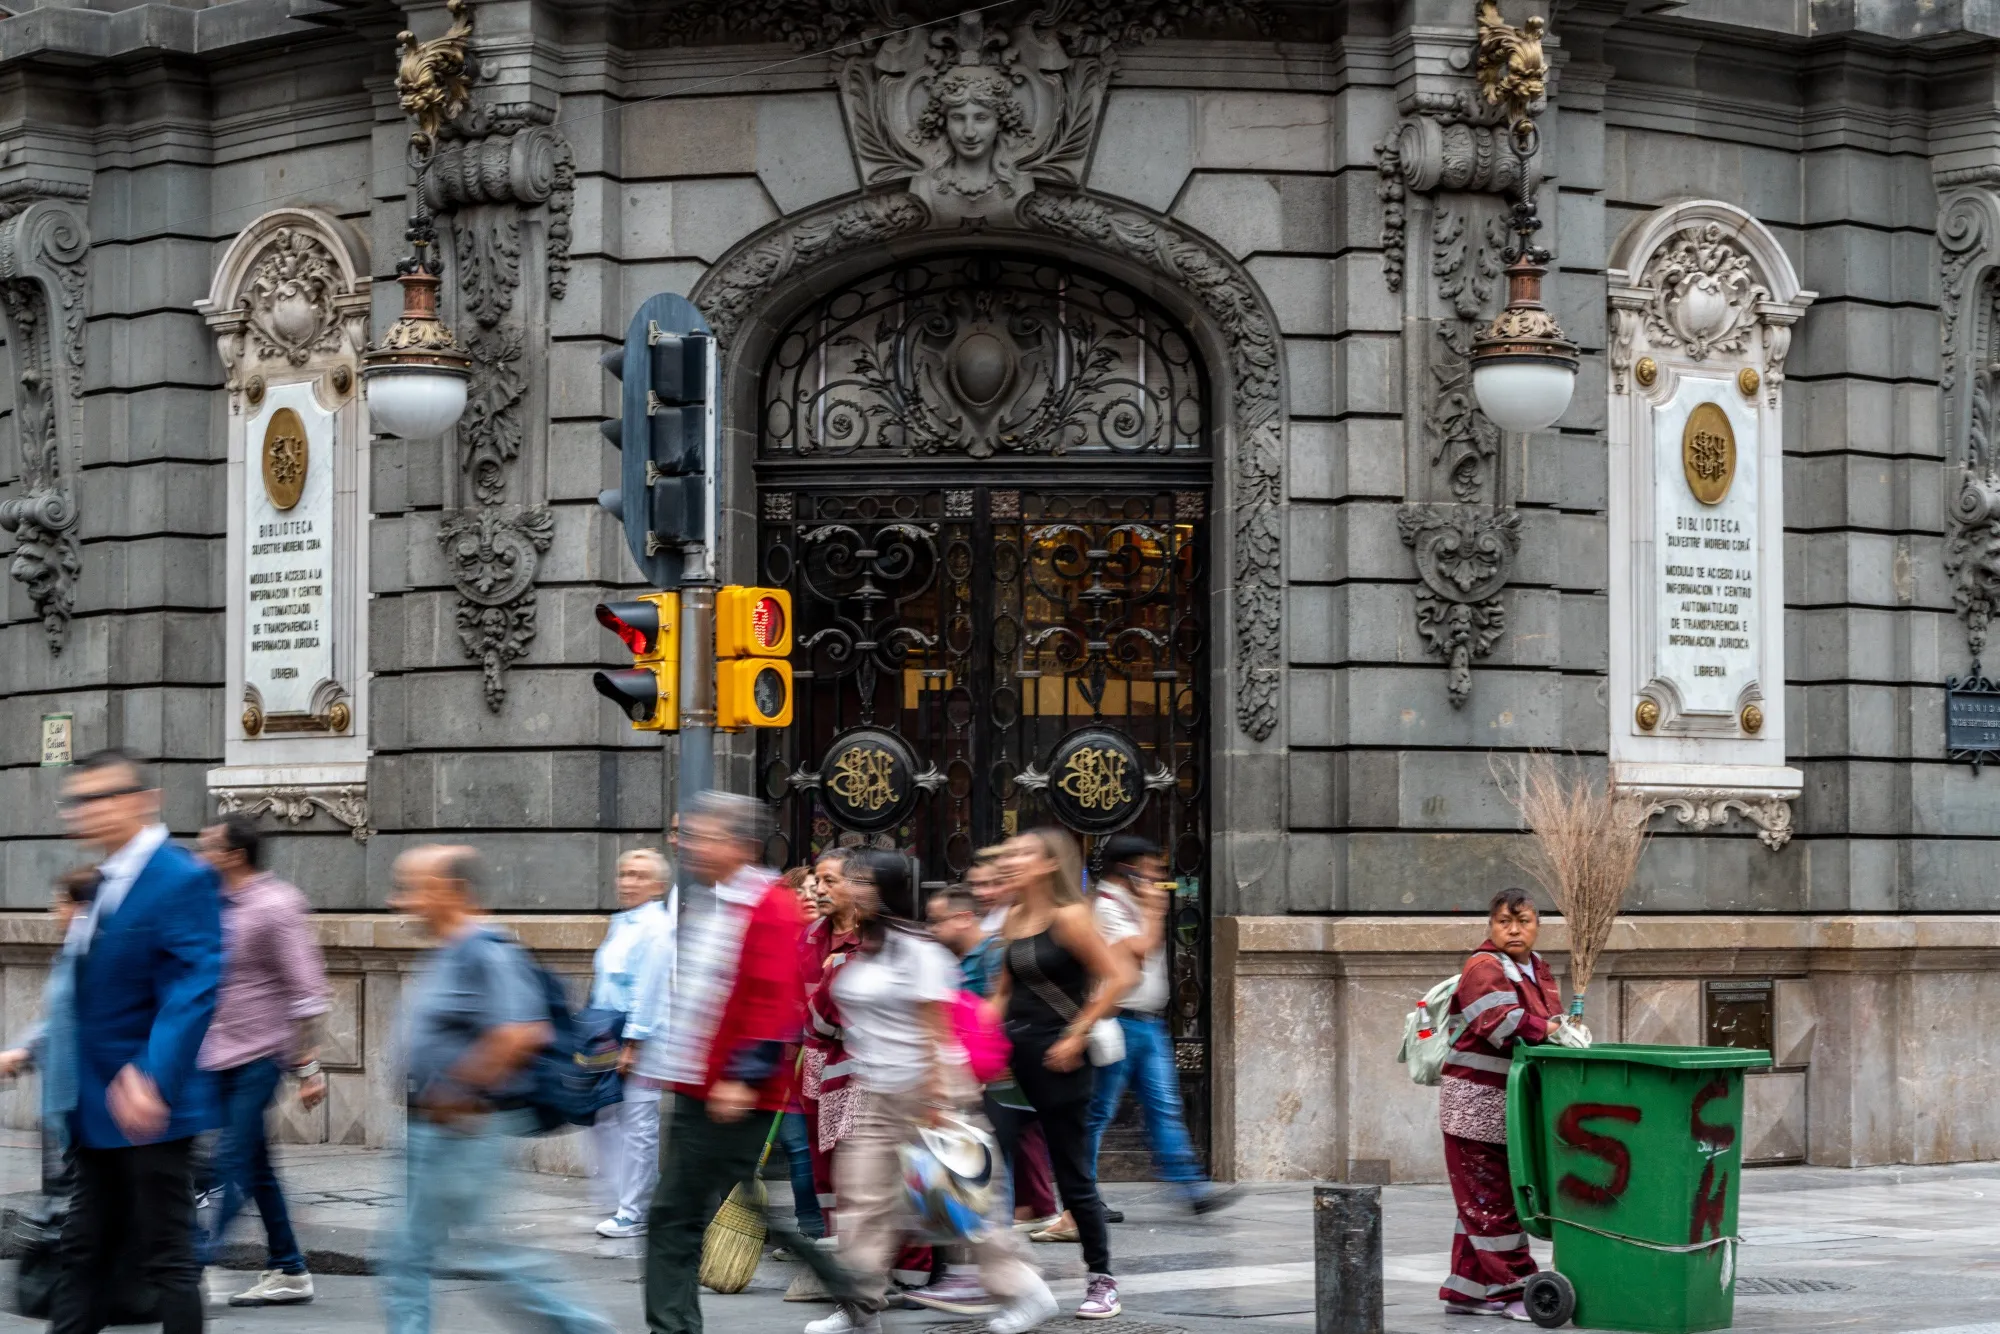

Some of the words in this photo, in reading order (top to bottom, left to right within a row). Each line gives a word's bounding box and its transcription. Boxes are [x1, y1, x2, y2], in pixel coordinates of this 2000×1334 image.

[259, 520, 313, 538] BIBLIOTECA
[1676, 516, 1740, 533] BIBLIOTECA
[1704, 537, 1730, 551] MORENO
[275, 571, 283, 583] DE
[284, 569, 308, 582] ACCESO
[309, 569, 314, 580] A
[315, 568, 322, 580] LA
[1696, 566, 1706, 579] DE
[1707, 567, 1734, 580] ACCESO
[1735, 569, 1741, 580] A
[1742, 569, 1752, 582] LA
[292, 587, 298, 598] Y
[299, 585, 323, 598] CENTRO
[1715, 585, 1722, 597] Y
[1724, 585, 1752, 599] CENTRO
[261, 603, 311, 617] AUTOMATIZADO
[1681, 601, 1739, 615] AUTOMATIZADO
[253, 623, 261, 635] DE
[263, 620, 312, 634] TRANSPARENCIA
[314, 619, 320, 631] E
[1670, 617, 1681, 630] DE
[1683, 618, 1741, 632] TRANSPARENCIA
[1742, 620, 1748, 632] E
[1557, 1103, 1642, 1208] S
